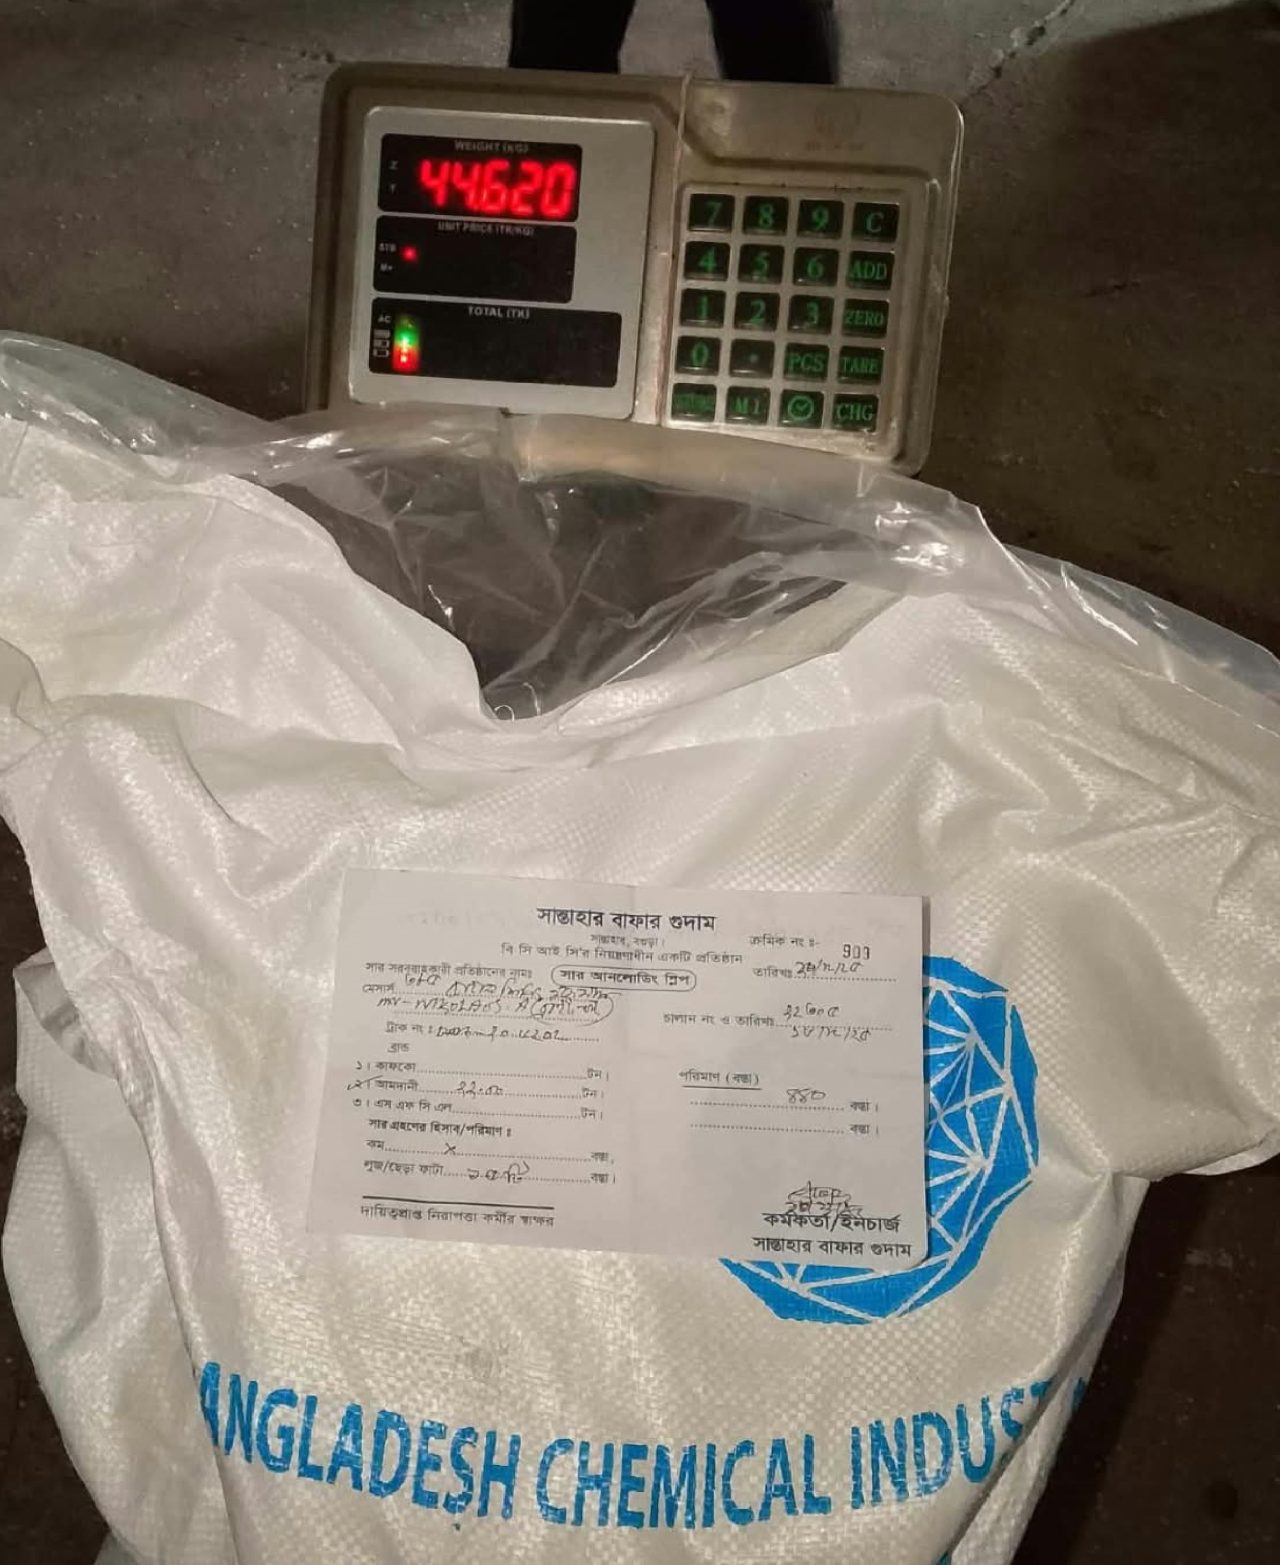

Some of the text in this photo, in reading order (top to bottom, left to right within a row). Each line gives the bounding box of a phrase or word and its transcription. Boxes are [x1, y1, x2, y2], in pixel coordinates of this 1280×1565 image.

[454, 140, 500, 151] WEIGHT
[705, 201, 722, 228] 7
[758, 203, 775, 229] 8
[811, 208, 829, 231] 9
[865, 211, 884, 233] C
[463, 222, 493, 234] PRICE
[699, 248, 717, 273] 4
[753, 252, 770, 276] 5
[807, 255, 824, 278] 6
[849, 260, 888, 280] ADD
[468, 306, 504, 318] TOTAL
[699, 296, 709, 320] 1
[749, 299, 767, 324] 2
[805, 302, 820, 325] 3
[844, 309, 884, 327] ZERO
[690, 341, 709, 368] 0
[787, 352, 825, 373] PCS
[842, 357, 879, 375] TARE
[836, 404, 874, 421] CHG
[536, 907, 717, 931] সান্তাহার বাফার গুদাম
[749, 933, 786, 946] ক্রমিক
[658, 950, 693, 962] একটি
[560, 969, 691, 986] সার আনলোডিং স্লিপ
[385, 1020, 407, 1034] ট্রাক
[663, 1013, 696, 1025] চালান
[701, 1014, 715, 1025] নং
[721, 1015, 731, 1025] ও
[369, 1119, 388, 1130] সার
[366, 1139, 385, 1151] কম
[419, 1163, 444, 1176] ফাটা
[752, 1237, 912, 1257] সান্তাহার বাফার গুদাম
[199, 1361, 522, 1520] ANGLADESH
[536, 1433, 831, 1530] CHEMICAL
